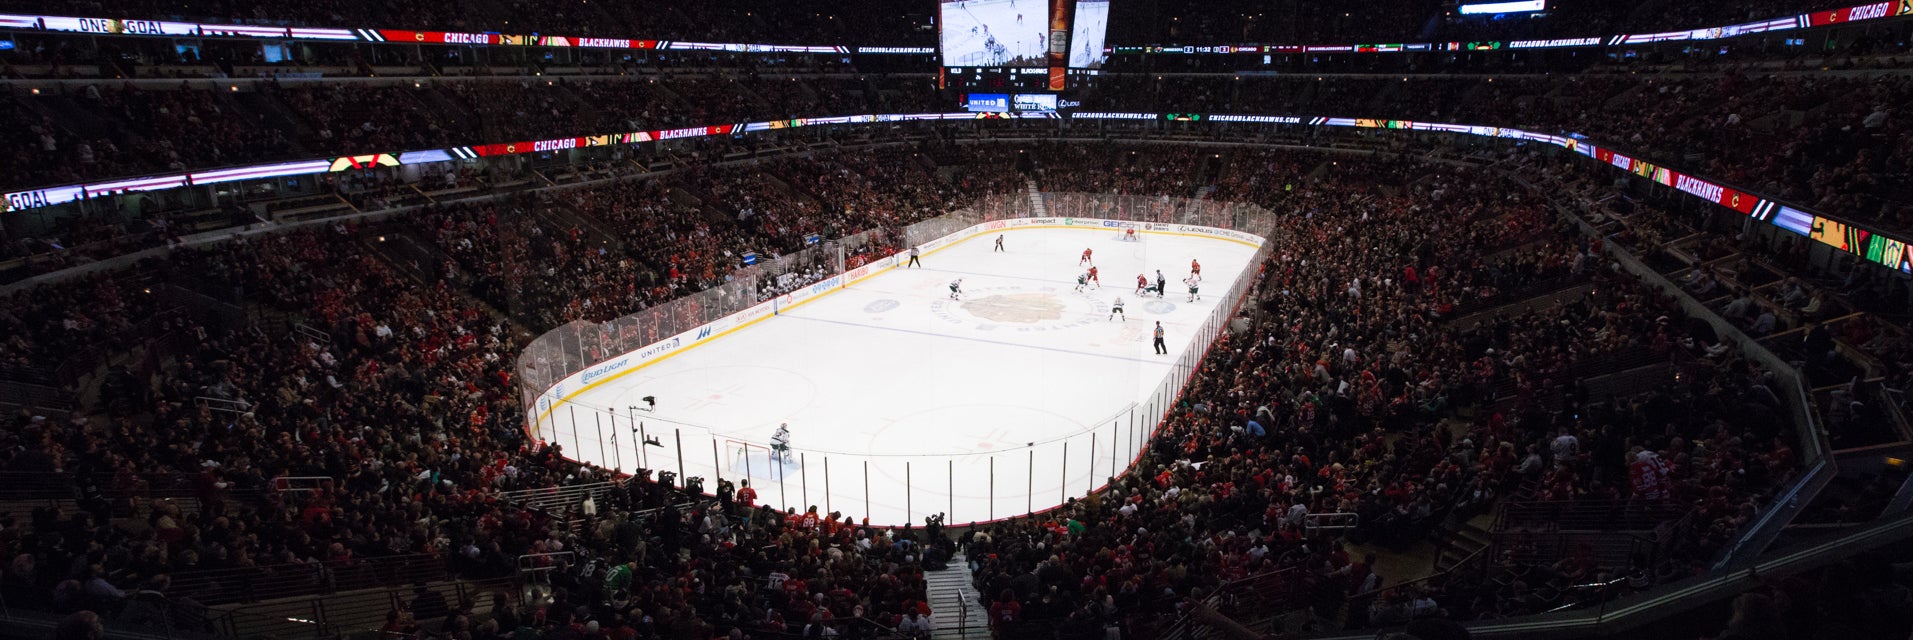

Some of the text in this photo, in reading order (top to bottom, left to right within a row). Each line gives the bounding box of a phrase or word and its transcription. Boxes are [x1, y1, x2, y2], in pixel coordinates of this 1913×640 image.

[1848, 2, 1890, 21] CHICAGO
[79, 18, 166, 34] ONE GOAL
[444, 32, 630, 49] CHICAGO BLACKHAWKS
[1509, 37, 1601, 48] CHICAGOBLACKHAWKS.COM
[1072, 112, 1157, 120] CHICAGOBLACKHAWKS.COM
[1209, 114, 1301, 124] CHICAGOBLACKHAWKS.COM
[534, 127, 708, 152] CHICAGO BLACKHAWKS
[1611, 154, 1724, 204] CHICAGO BLACKHAWKS
[10, 190, 51, 209] GOAL
[641, 342, 671, 358] UNITED
[584, 359, 629, 382] BUD LIGHT
